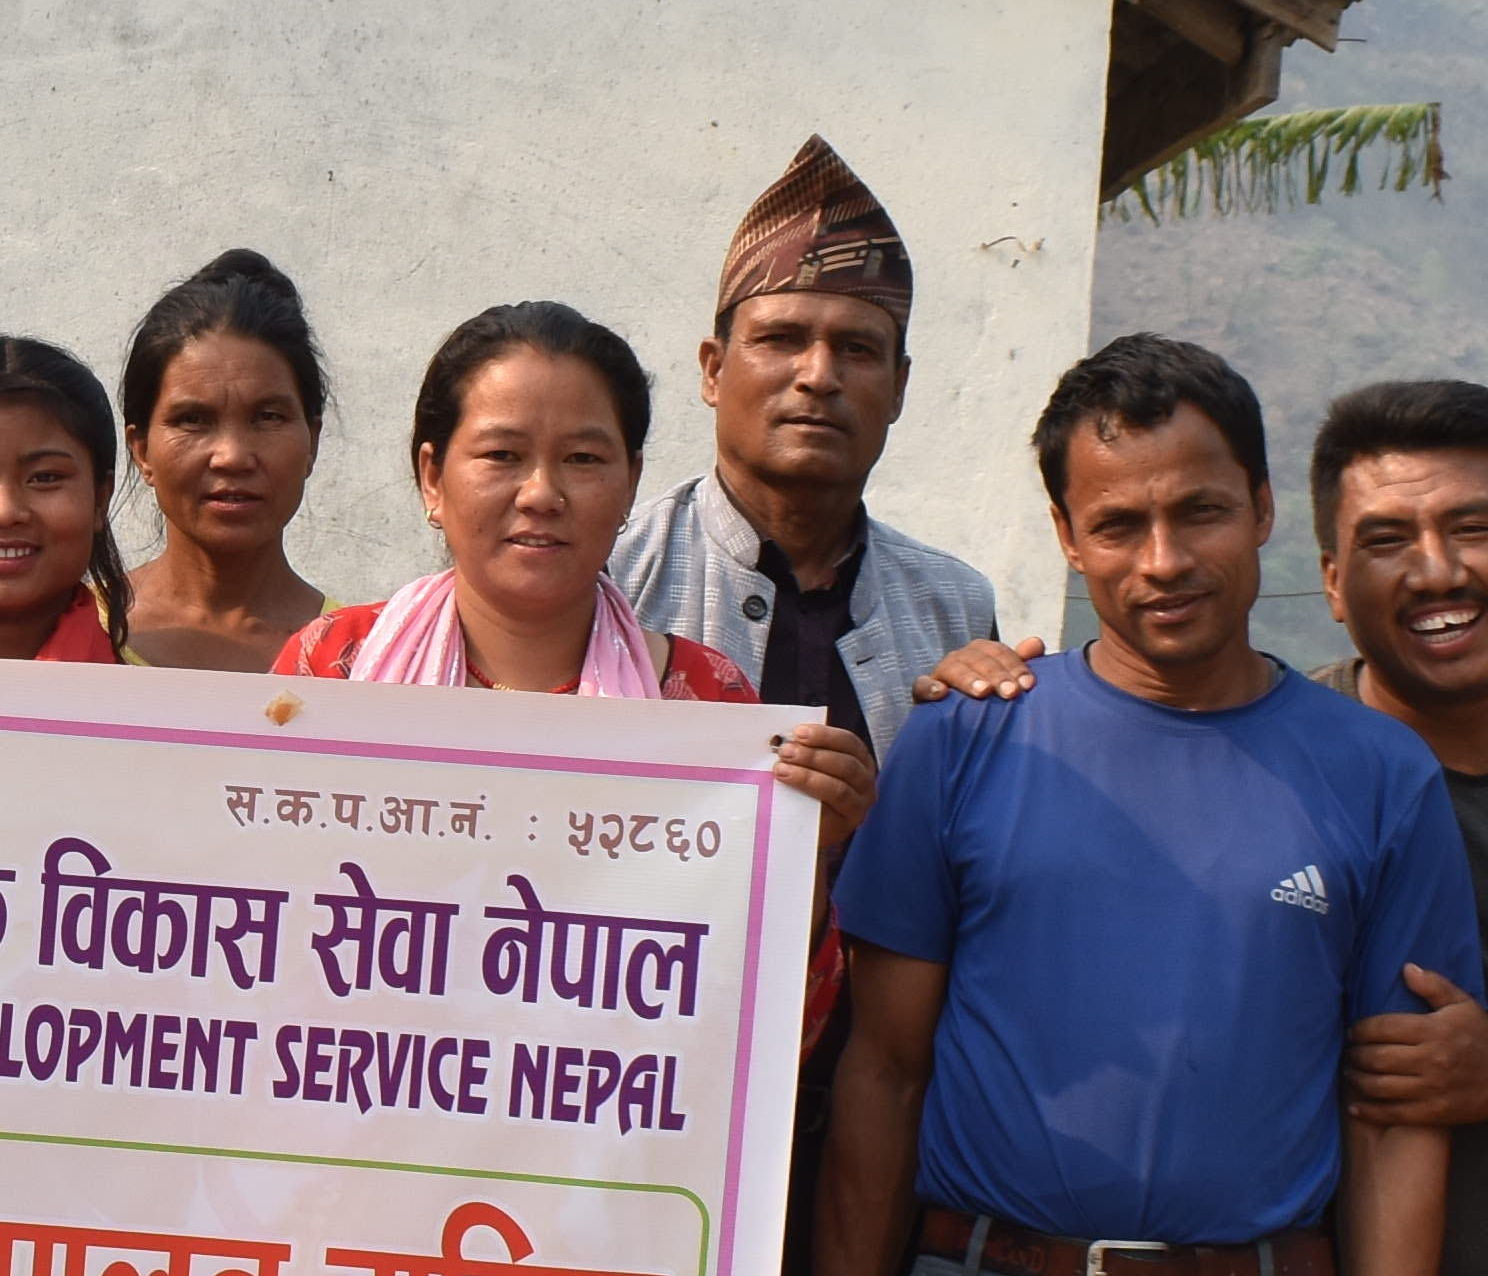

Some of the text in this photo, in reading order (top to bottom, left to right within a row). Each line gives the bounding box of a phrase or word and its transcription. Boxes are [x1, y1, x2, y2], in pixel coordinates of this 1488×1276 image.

[568, 810, 721, 862] ५२८६०
[39, 837, 290, 990] विकास
[311, 862, 460, 997] सेवा
[482, 874, 709, 1019] नेपाल
[1270, 888, 1329, 915] adidas
[272, 1024, 490, 1114] SERVICE
[509, 1043, 686, 1136] NEPAL
